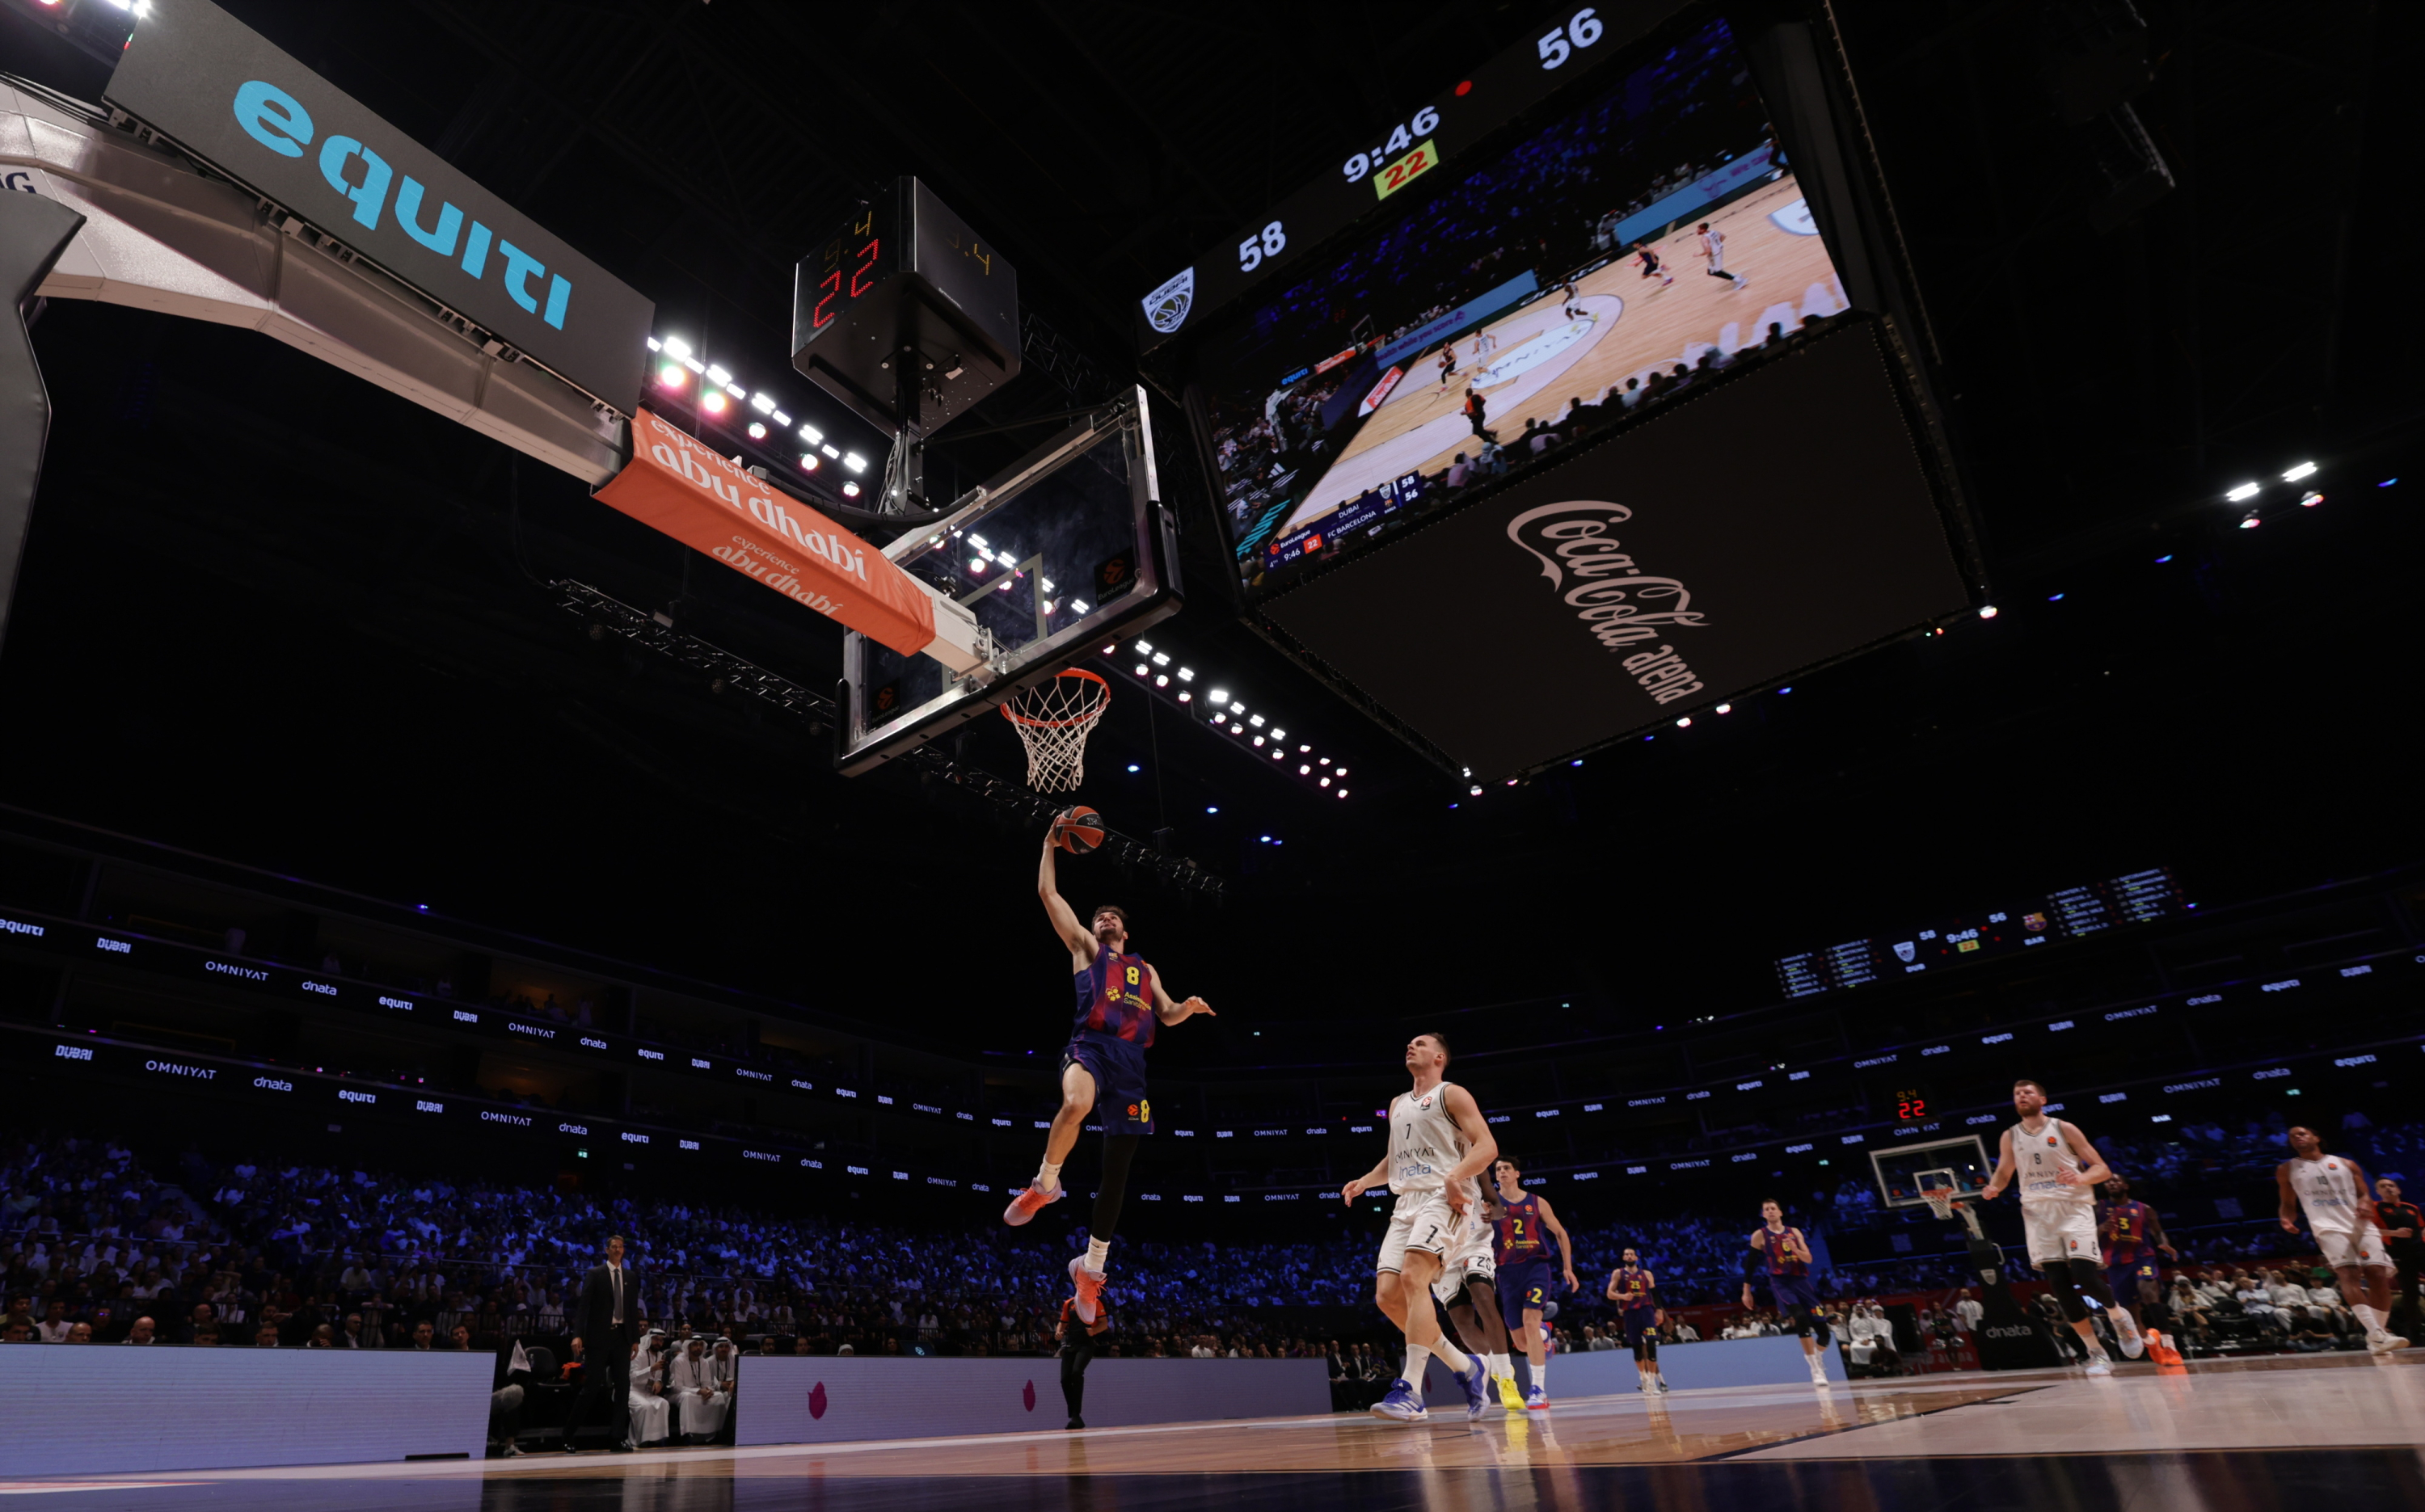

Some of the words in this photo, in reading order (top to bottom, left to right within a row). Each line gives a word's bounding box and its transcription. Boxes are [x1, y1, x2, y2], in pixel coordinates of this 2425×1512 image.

[1537, 7, 1603, 70] 56
[1343, 105, 1440, 183] 9:46
[1385, 150, 1427, 191] 22
[233, 79, 571, 331] equiti
[1239, 220, 1286, 272] 58
[813, 238, 879, 328] 22
[1280, 368, 1309, 385] equiti
[651, 419, 771, 495] experience
[1402, 475, 1415, 488] 58
[1405, 488, 1419, 502] 56
[652, 440, 743, 510] abu
[749, 496, 869, 583] dhabi
[1338, 503, 1360, 519] DUBAI
[1327, 529, 1336, 539] FC
[1336, 510, 1377, 535] BARCELONA
[1280, 529, 1311, 549] EuroLeague
[1307, 539, 1318, 550] 22
[732, 534, 799, 575] experience
[1284, 548, 1301, 562] 9:46
[711, 543, 765, 579] abu
[764, 573, 845, 617] dhabi
[1098, 576, 1136, 601] EuroLeague
[1507, 499, 1712, 647] Coca-Cola
[1622, 644, 1704, 705] arena
[1988, 912, 2007, 923] 56
[1918, 929, 1937, 941] 58
[1946, 929, 1979, 944] 9:46
[2023, 936, 2046, 946] BAR
[96, 937, 132, 954] DUBAI
[205, 961, 269, 981] OMNIYAT
[1905, 962, 1926, 973] DUB
[1126, 966, 1140, 986] 8
[302, 980, 338, 996] dnata
[378, 996, 413, 1011] equiti
[453, 1009, 479, 1023] DUBAI
[508, 1022, 556, 1038] OMNIYAT
[580, 1037, 607, 1050] dnata
[55, 1044, 94, 1061] DUBAI
[638, 1048, 664, 1060] equiti
[146, 1059, 217, 1080] OMNIYAT
[691, 1058, 711, 1069] DUBAI
[736, 1068, 773, 1081] OMNIYAT
[253, 1076, 293, 1092] dnata
[791, 1079, 812, 1090] dnata
[338, 1089, 377, 1104] equiti
[836, 1088, 857, 1098] equiti
[1896, 1088, 1918, 1103] 9.4
[416, 1100, 444, 1114] DUBAI
[913, 1103, 942, 1114] OMNIYAT
[1140, 1099, 1150, 1123] 8
[1535, 1109, 1560, 1118] equiti
[1898, 1099, 1925, 1120] 22
[480, 1111, 532, 1127] OMNIYAT
[956, 1111, 973, 1121] dnata
[991, 1118, 1012, 1127] equiti
[1488, 1114, 1511, 1123] dnata
[559, 1122, 588, 1135] dnata
[1254, 1129, 1288, 1137] OMNIYAT
[1350, 1126, 1373, 1134] equiti
[1406, 1123, 1412, 1139] 7
[1893, 1122, 1939, 1135] OMNYAT
[621, 1131, 650, 1143] equiti
[679, 1139, 700, 1151] DUBAI
[743, 1150, 781, 1162] OMNIYAT
[2034, 1152, 2042, 1165] 8
[800, 1158, 823, 1169] dnata
[846, 1165, 869, 1175] equiti
[926, 1177, 957, 1187] OMNIYAT
[1523, 1176, 1547, 1186] dnata
[1573, 1172, 1599, 1181] equiti
[2317, 1176, 2329, 1186] 10
[972, 1183, 989, 1192] dnata
[1365, 1190, 1388, 1198] equiti
[1141, 1193, 1162, 1201] dnata
[1183, 1194, 1204, 1202] equiti
[1264, 1194, 1300, 1202] OMNIYAT
[1319, 1191, 1340, 1199] dnata
[1513, 1219, 1524, 1234] 2
[2119, 1217, 2129, 1230] 3
[1425, 1224, 1439, 1244] 7
[2142, 1266, 2152, 1276] 3
[1531, 1287, 1543, 1304] 2
[1985, 1324, 2033, 1338] dnata
